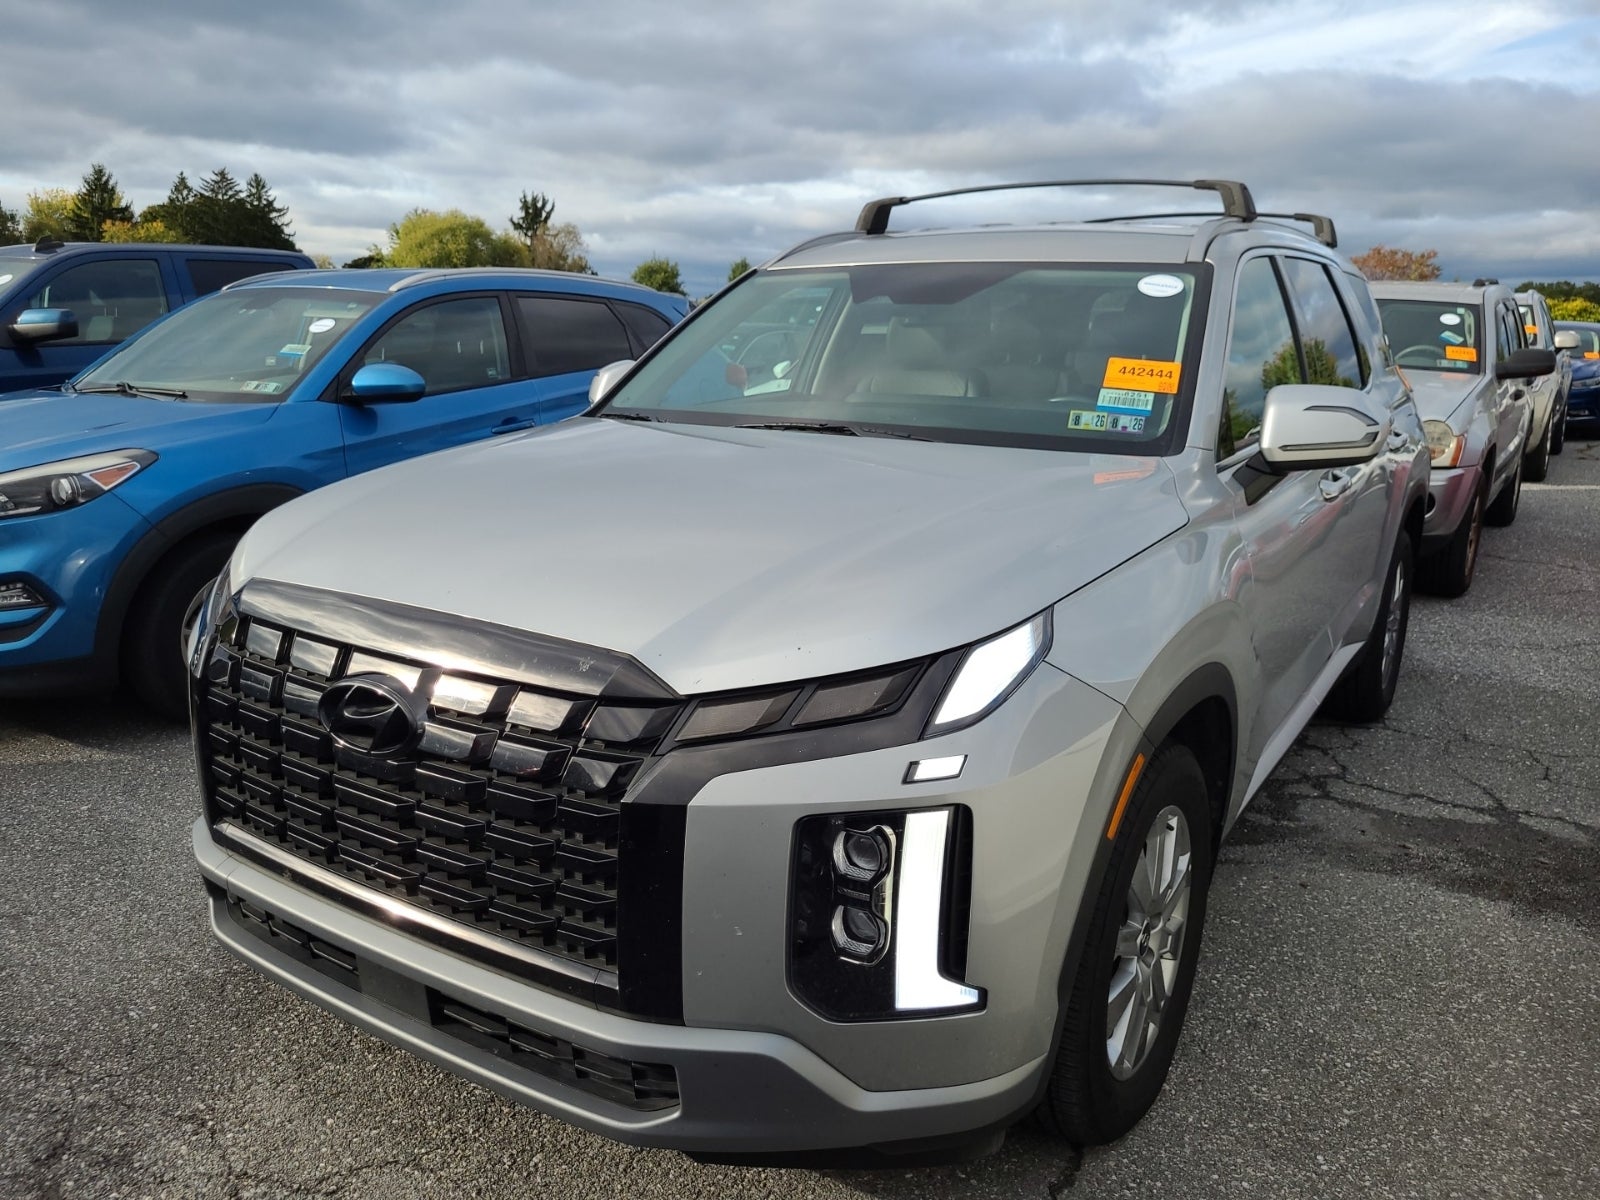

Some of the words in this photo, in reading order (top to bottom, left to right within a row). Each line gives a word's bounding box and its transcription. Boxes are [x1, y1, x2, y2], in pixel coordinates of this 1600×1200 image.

[1118, 366, 1173, 379] 442444
[1074, 415, 1080, 426] 8
[1095, 414, 1105, 427] 26
[1132, 417, 1143, 430] 26
